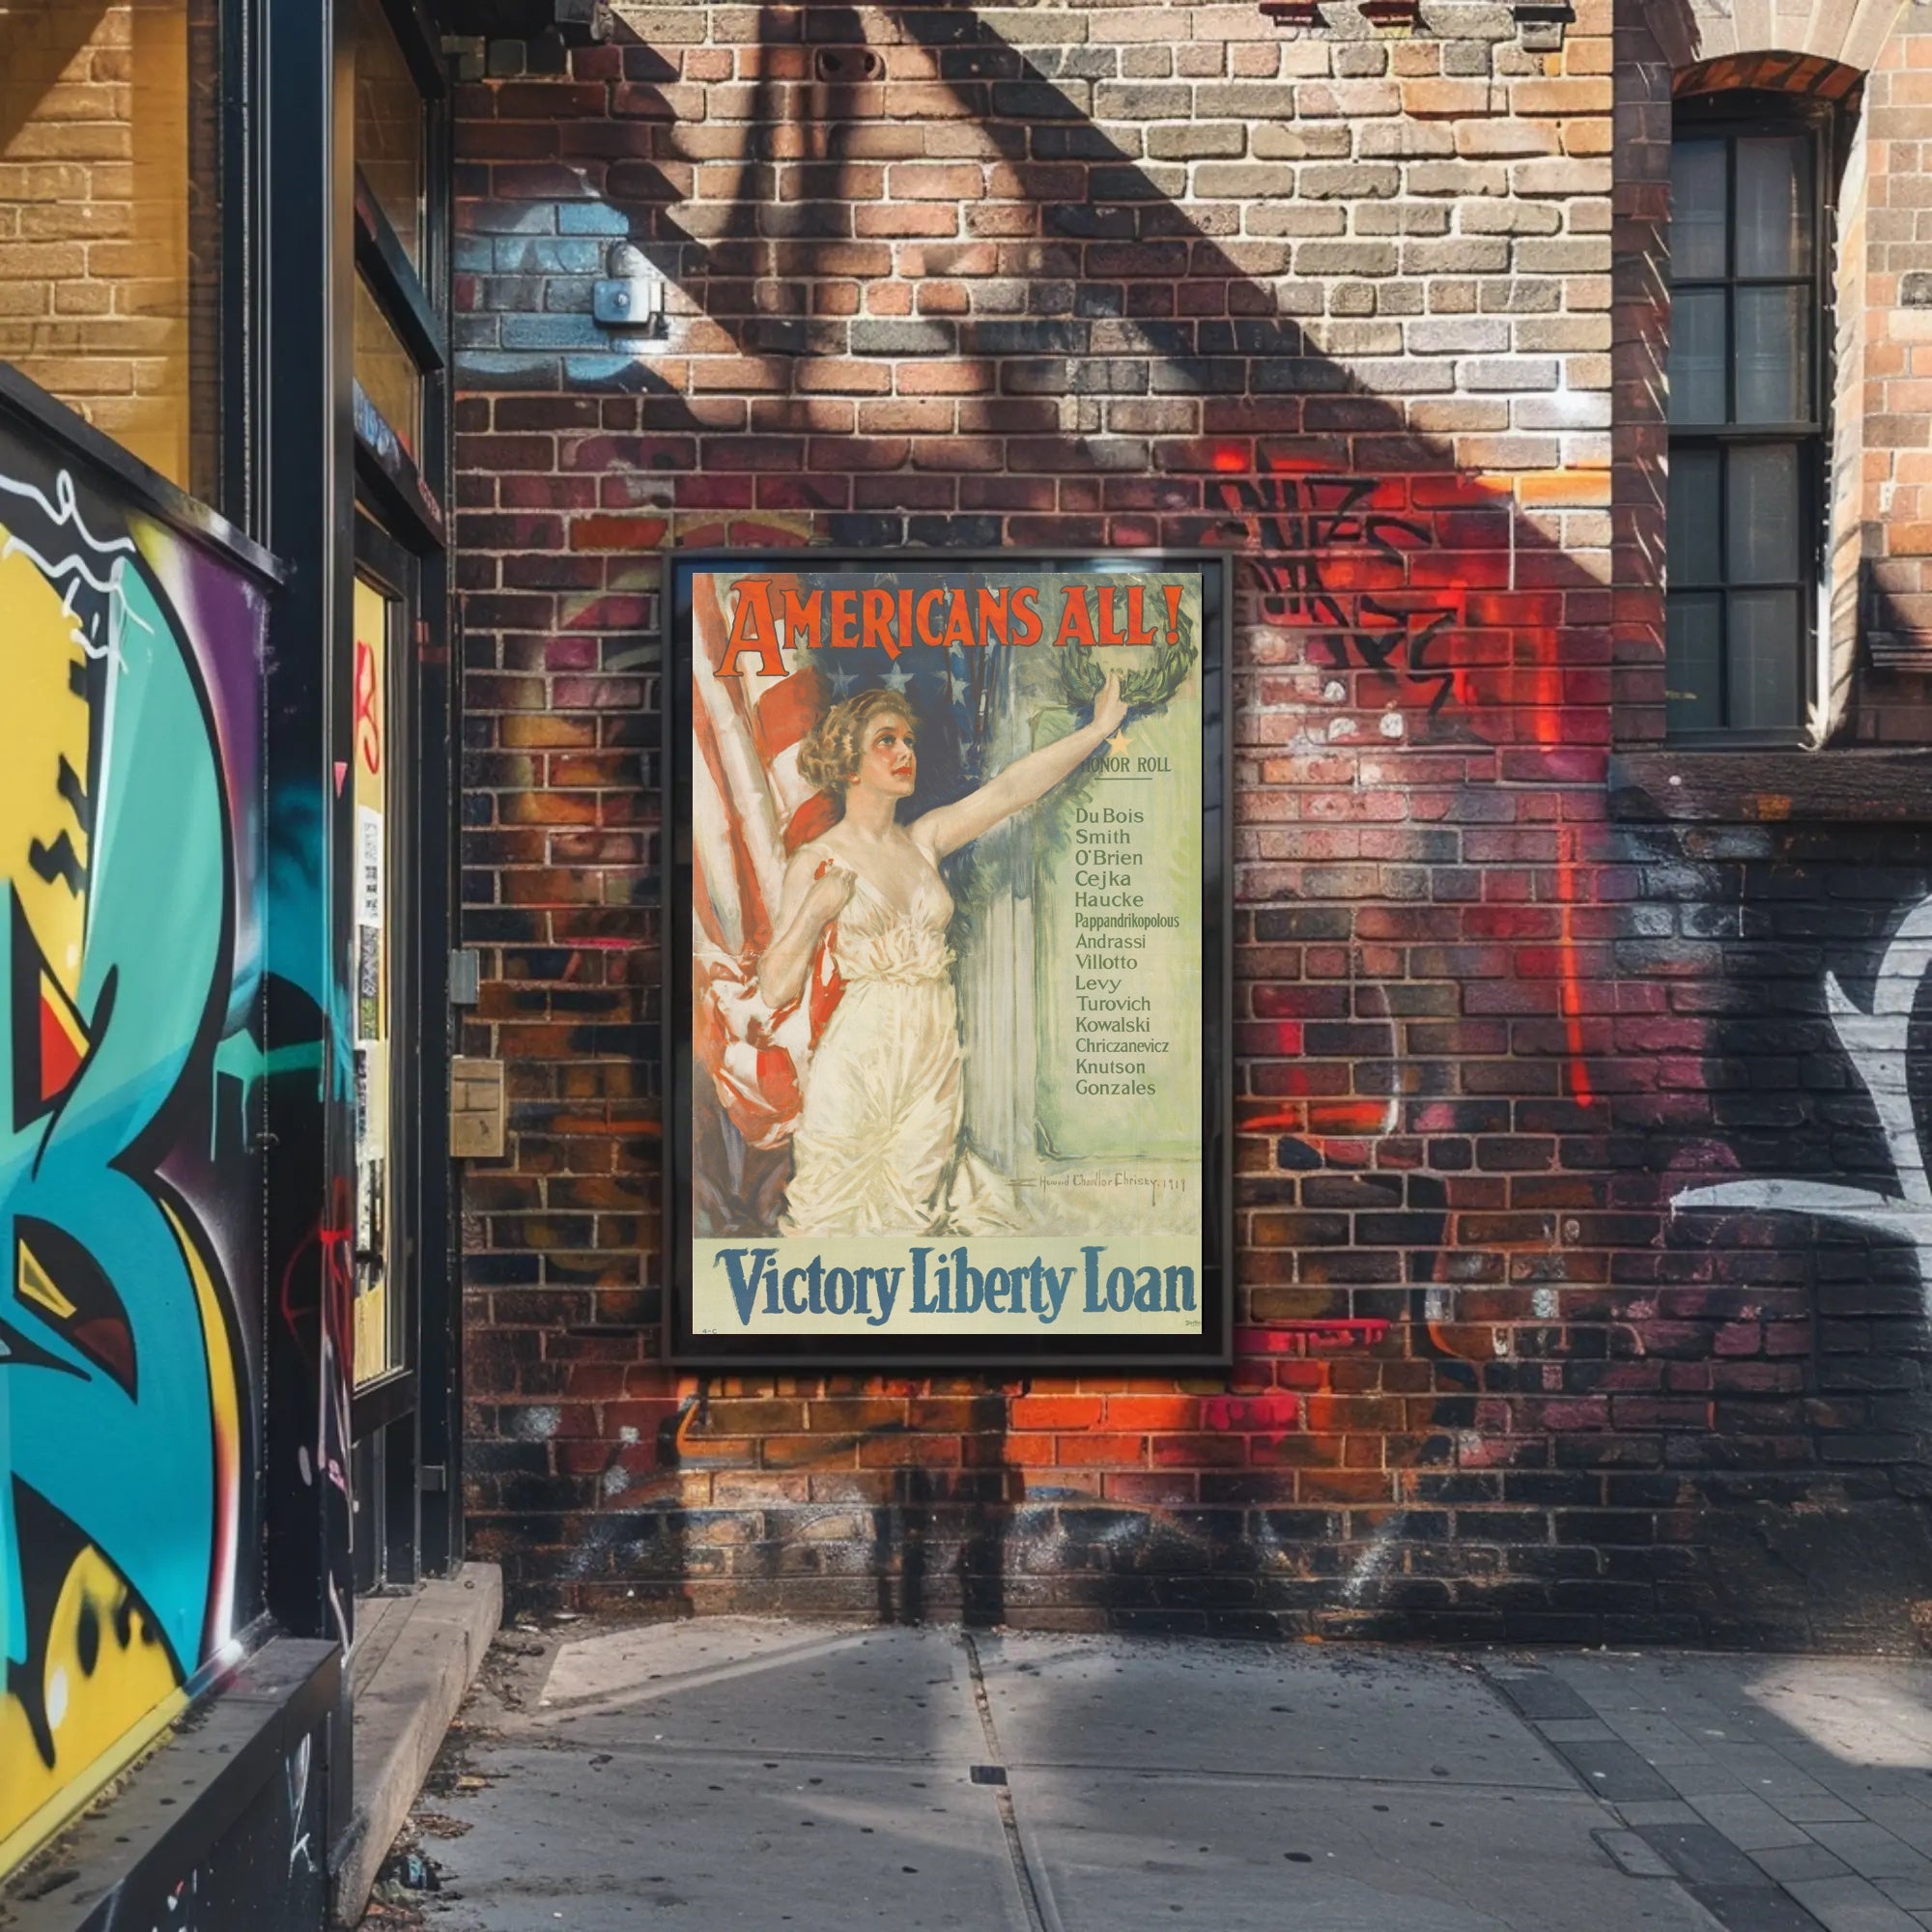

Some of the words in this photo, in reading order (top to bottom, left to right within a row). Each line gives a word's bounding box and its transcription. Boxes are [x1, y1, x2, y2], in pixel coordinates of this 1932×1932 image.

[713, 580, 1042, 676] AMERICANS
[1053, 584, 1184, 646] ALL!
[1081, 756, 1130, 772] HONOR
[1137, 756, 1172, 772] ROLL
[1075, 829, 1131, 844] Smith
[1075, 849, 1143, 866] O'Brien
[1075, 870, 1131, 890] Cejka
[1075, 892, 1144, 907] Haucke
[1074, 912, 1179, 931] Pappandrikopolous
[1075, 933, 1146, 949] Andrassi
[1075, 953, 1138, 969] Villotto
[1075, 975, 1122, 994] Levy
[1076, 996, 1151, 1011] Turovich
[1075, 1017, 1151, 1033] Kowalski
[1075, 1037, 1170, 1053] Chriczanevicz
[1076, 1059, 1146, 1074] Knutson
[1075, 1079, 1156, 1095] Gonzales
[713, 1247, 905, 1326] Victory
[909, 1246, 1077, 1324] Liberty
[1080, 1245, 1197, 1314] Loan
